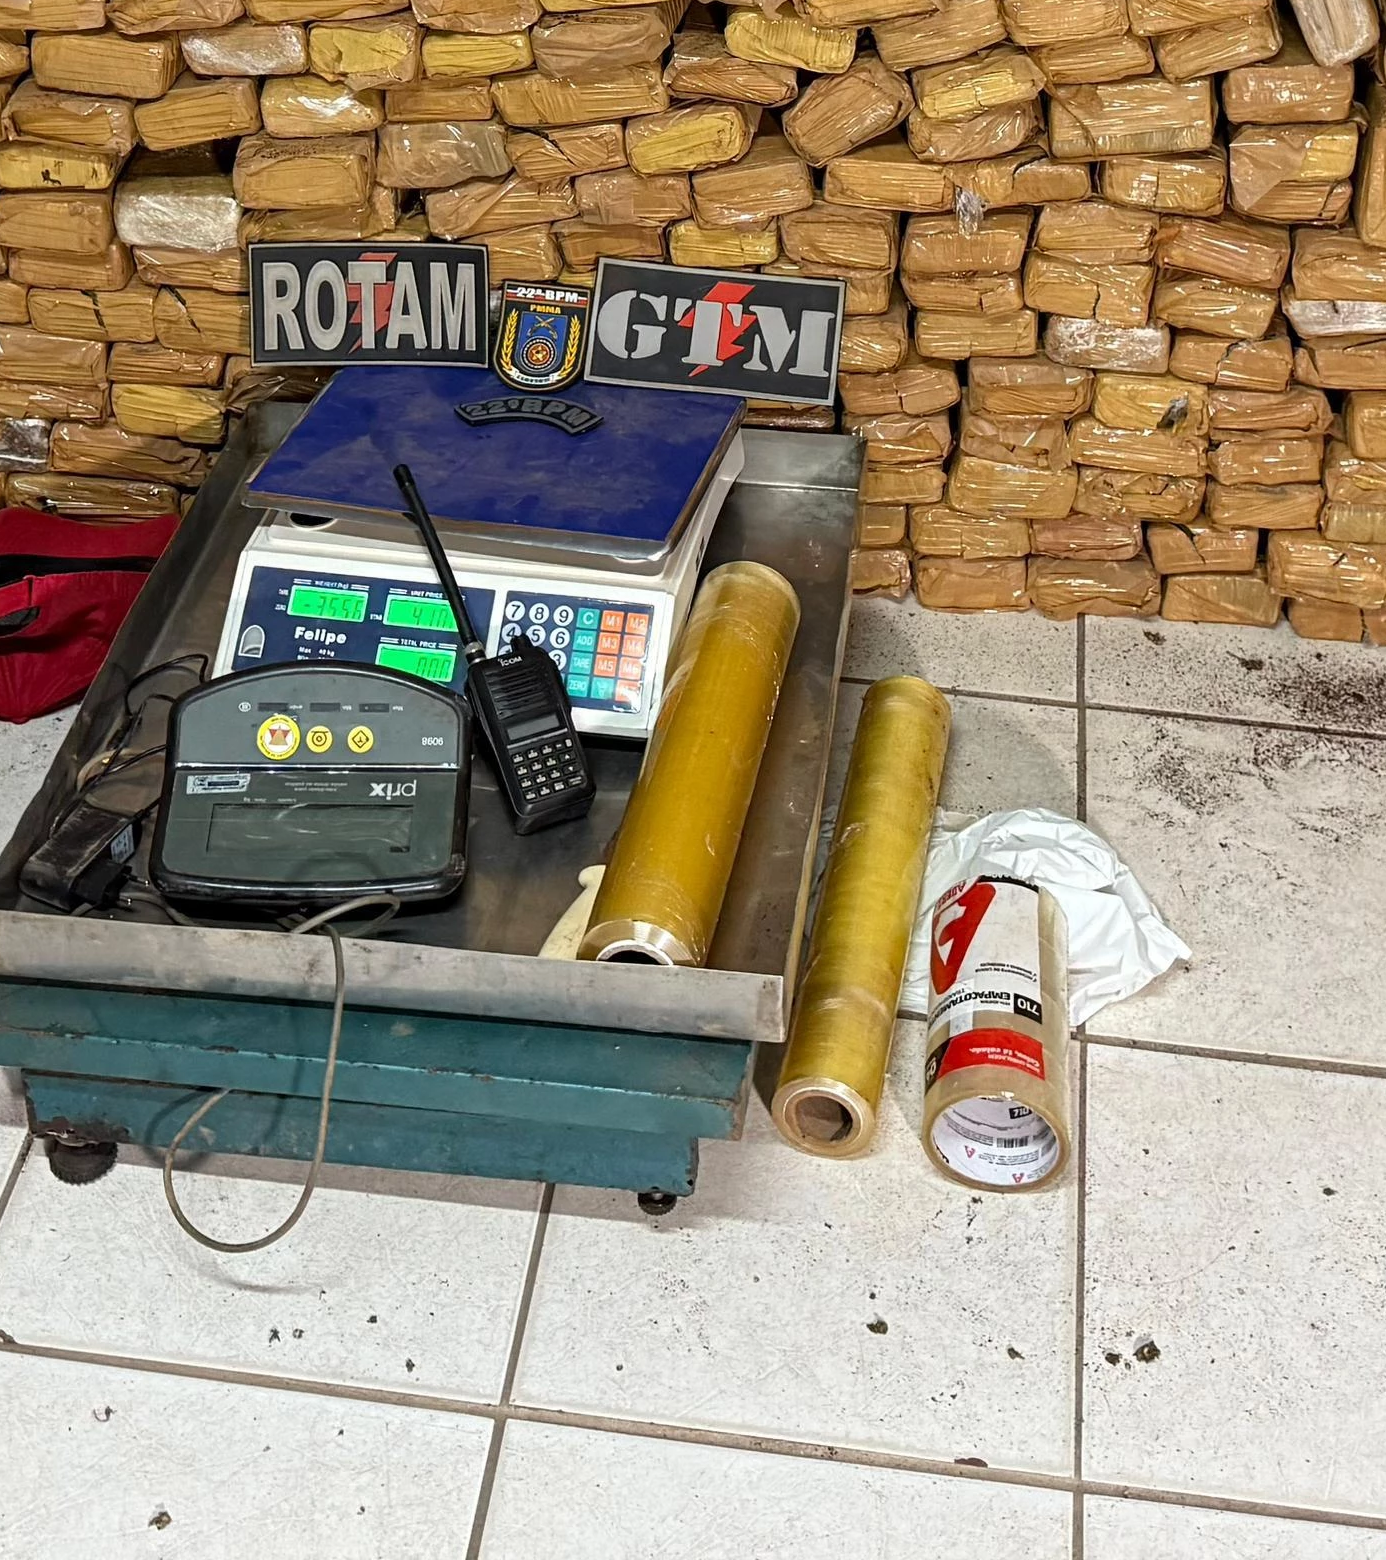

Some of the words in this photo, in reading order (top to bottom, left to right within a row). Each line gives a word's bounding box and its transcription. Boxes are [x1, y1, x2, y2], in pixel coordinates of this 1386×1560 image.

[262, 259, 477, 351] ROTAM
[529, 304, 561, 314] PMMA
[597, 289, 835, 378] GTM
[511, 604, 521, 618] 7
[534, 606, 544, 620] 8
[559, 609, 569, 623] 9
[583, 611, 594, 625] C
[506, 626, 516, 637] 4
[531, 629, 541, 642] 5
[555, 631, 566, 645] 6
[576, 635, 593, 646] ADD
[573, 657, 590, 668] TARE
[598, 660, 613, 671] M5
[569, 681, 587, 691] ZERO
[422, 735, 444, 746] 9098
[369, 779, 417, 801] prix
[1017, 997, 1040, 1016] 710
